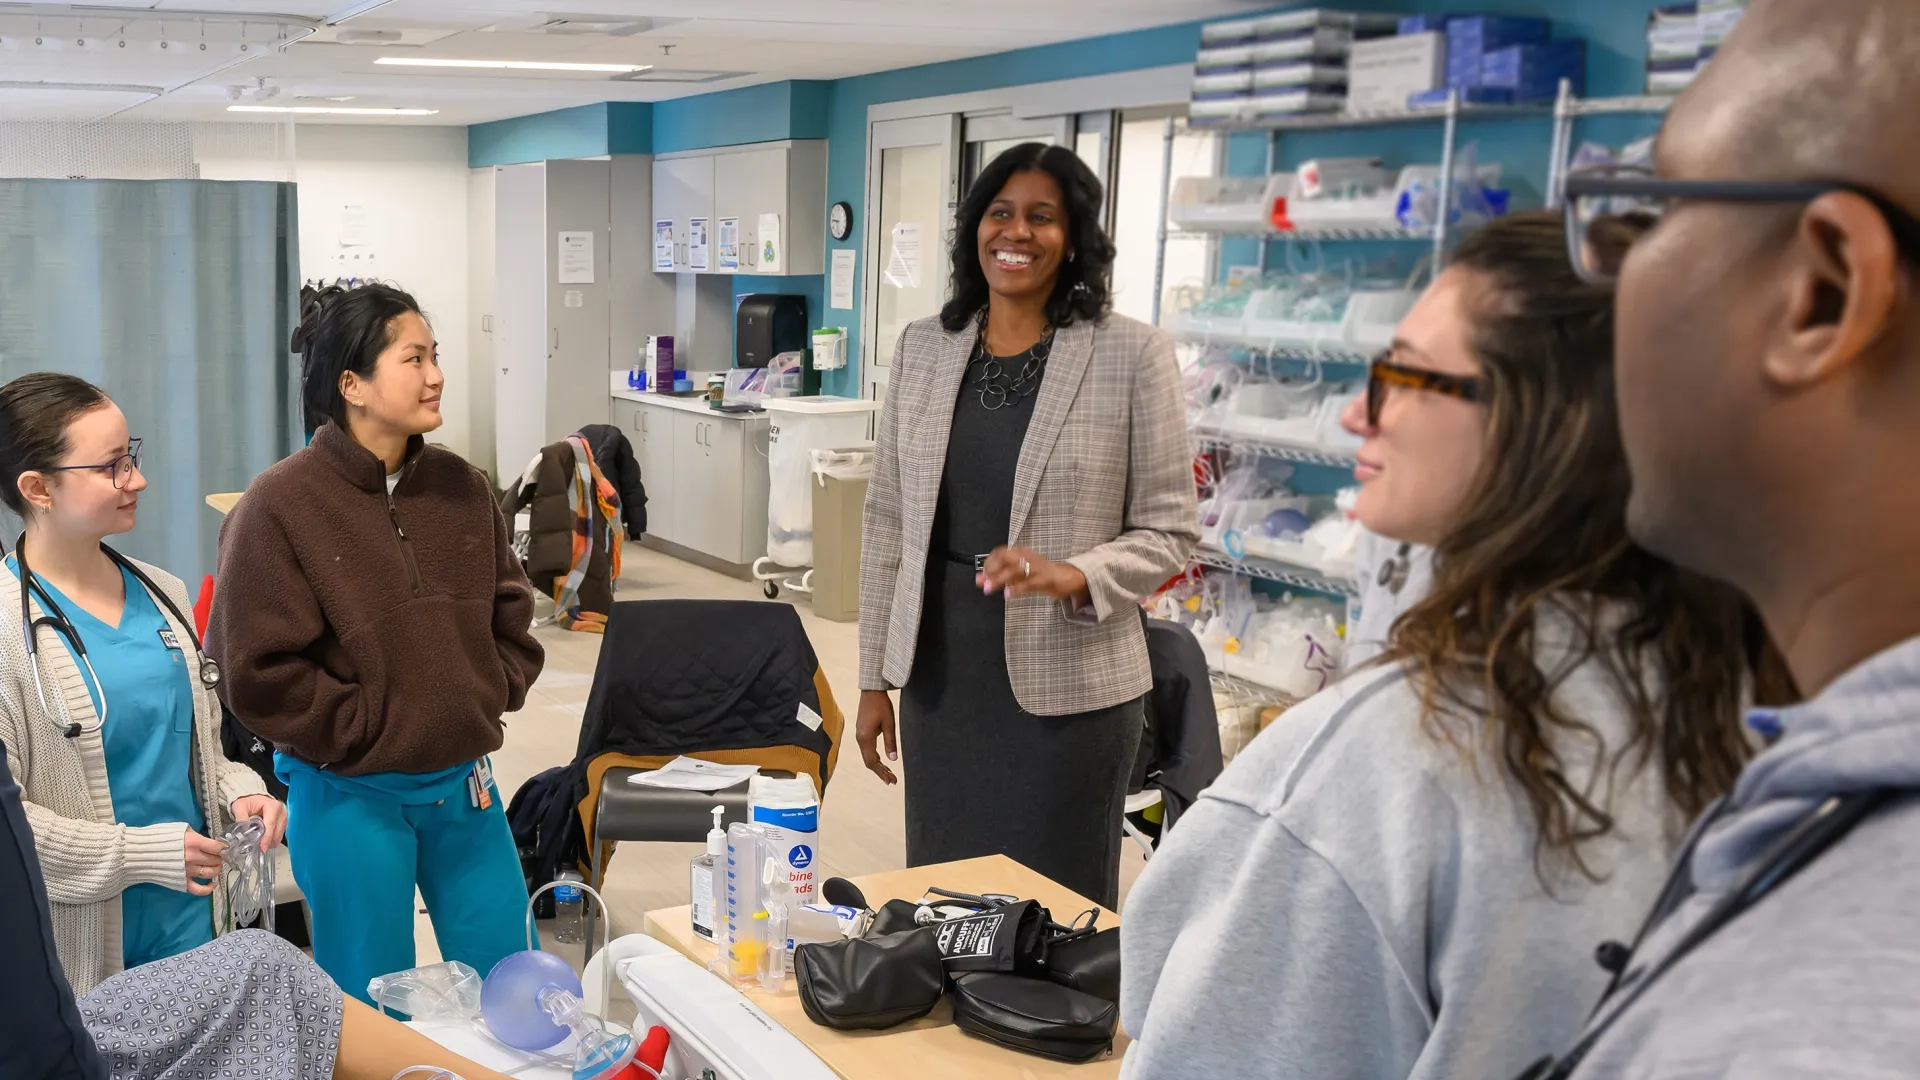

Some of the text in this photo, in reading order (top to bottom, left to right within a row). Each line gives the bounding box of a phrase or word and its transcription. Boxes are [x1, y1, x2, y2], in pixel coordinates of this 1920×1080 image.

[789, 871, 813, 881] bine
[794, 883, 813, 894] ads
[953, 920, 970, 953] ADCUFF
